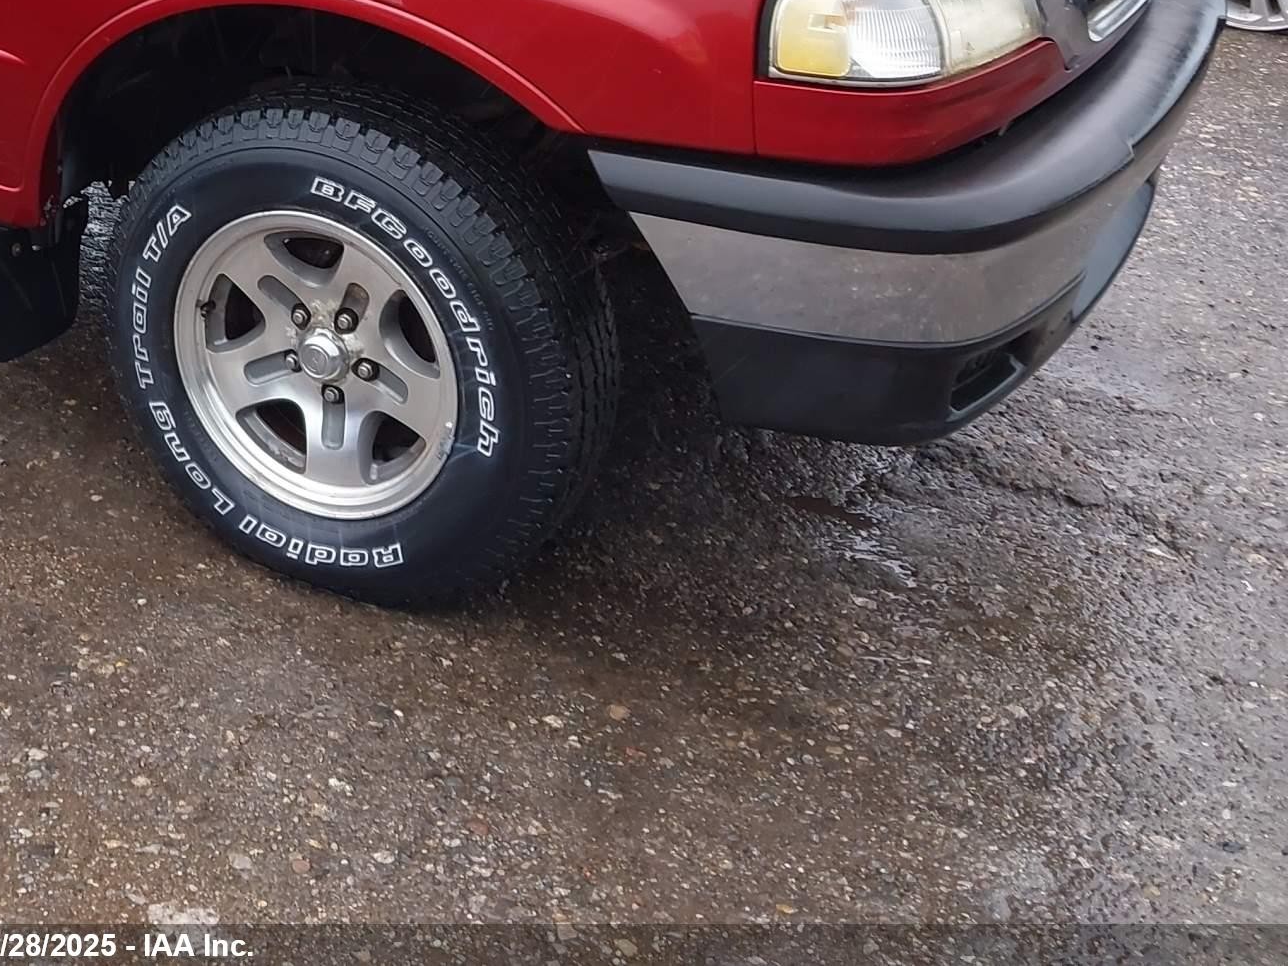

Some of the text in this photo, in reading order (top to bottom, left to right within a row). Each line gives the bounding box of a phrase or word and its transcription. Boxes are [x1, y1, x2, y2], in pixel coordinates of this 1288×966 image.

[128, 204, 405, 569] Radial Long Trail T/A
[310, 177, 502, 457] BFGoodrich
